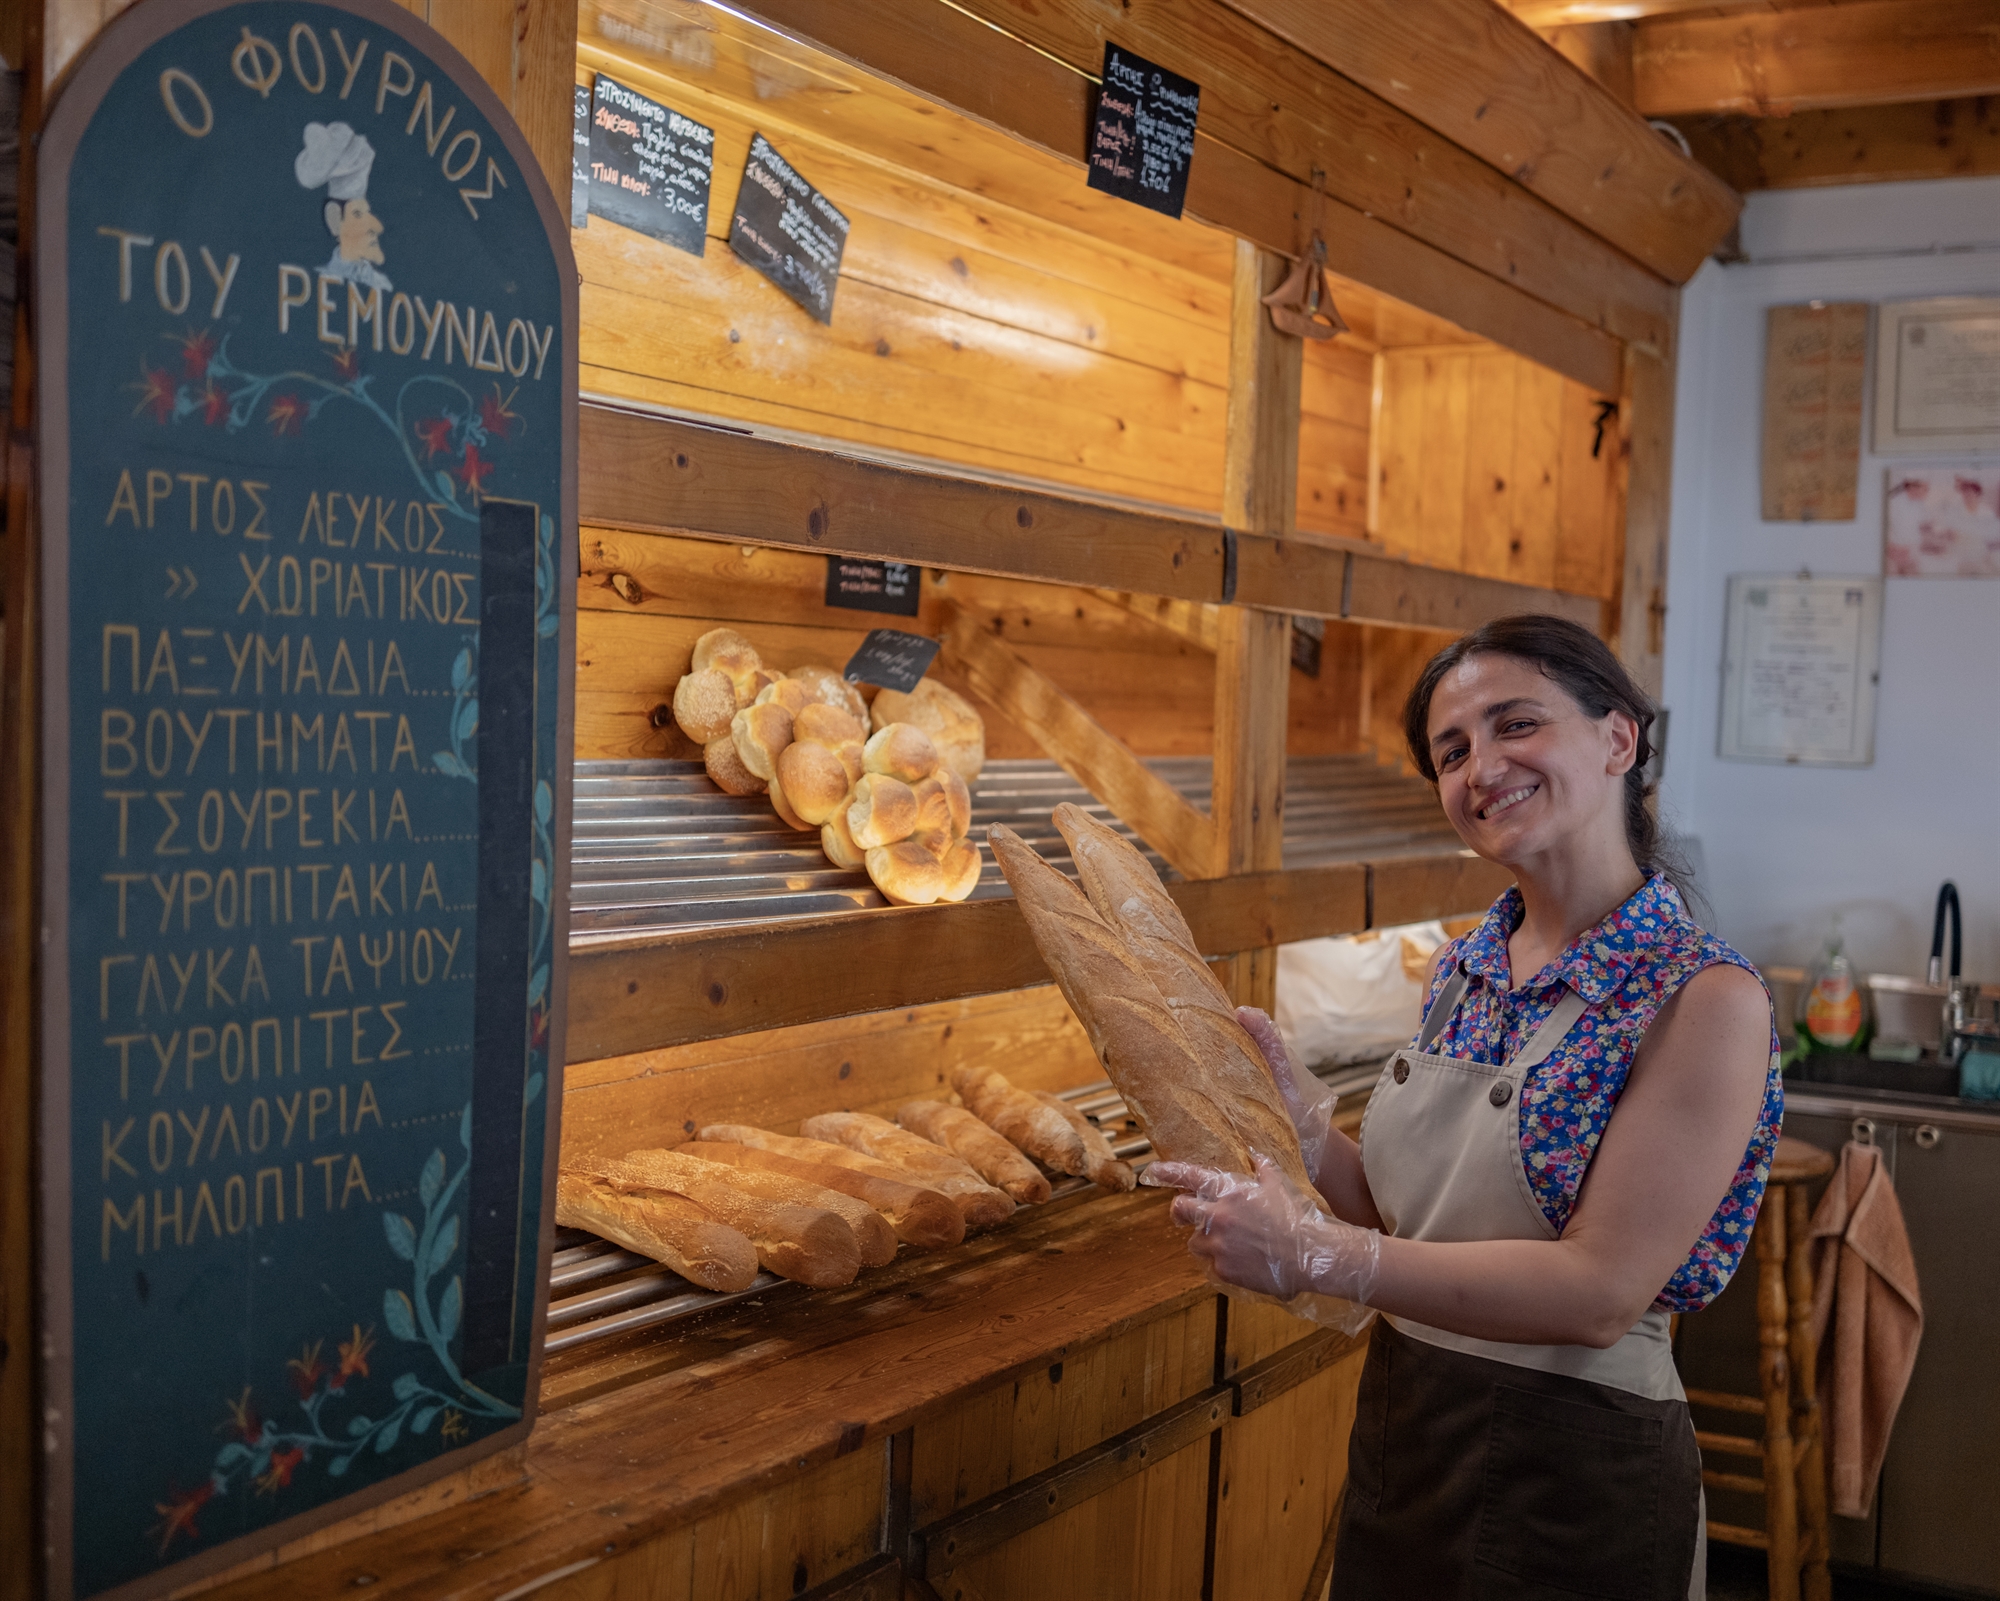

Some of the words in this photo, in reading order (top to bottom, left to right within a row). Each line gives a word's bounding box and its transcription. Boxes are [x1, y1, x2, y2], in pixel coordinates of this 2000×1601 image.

[160, 68, 213, 137] Ο
[232, 22, 508, 221] ΦΟΥΡΝΟΣ
[97, 227, 241, 319] ΤΟΥ
[278, 264, 554, 380] ΡΕΜΟΥΝΔΟΥ
[106, 468, 273, 540] ΑΡΤΟΣ
[299, 491, 449, 554] ΛΕΥΚΟΣ
[103, 624, 411, 697] ΠΑΞΥΜΑΔΙΑ
[102, 707, 419, 778] ΒΟΥΤΗΜΑΤΑ
[104, 788, 413, 857] ΤΣΟΥΡΕΚΙΑ
[104, 861, 444, 939] ΤΥΡΟΠΙΤΑΚΙΑ
[101, 945, 271, 1021] ΓΛΥΚΑ
[292, 926, 462, 997] ΤΑΨΙΟΥ
[104, 1001, 412, 1100] ΤΥΡΟΠΙΤΕΣ
[102, 1080, 383, 1181] ΚΟΥΛΟΥΡΙΑ
[102, 1153, 373, 1262] ΜΗΛΟΠΙΤΑ
